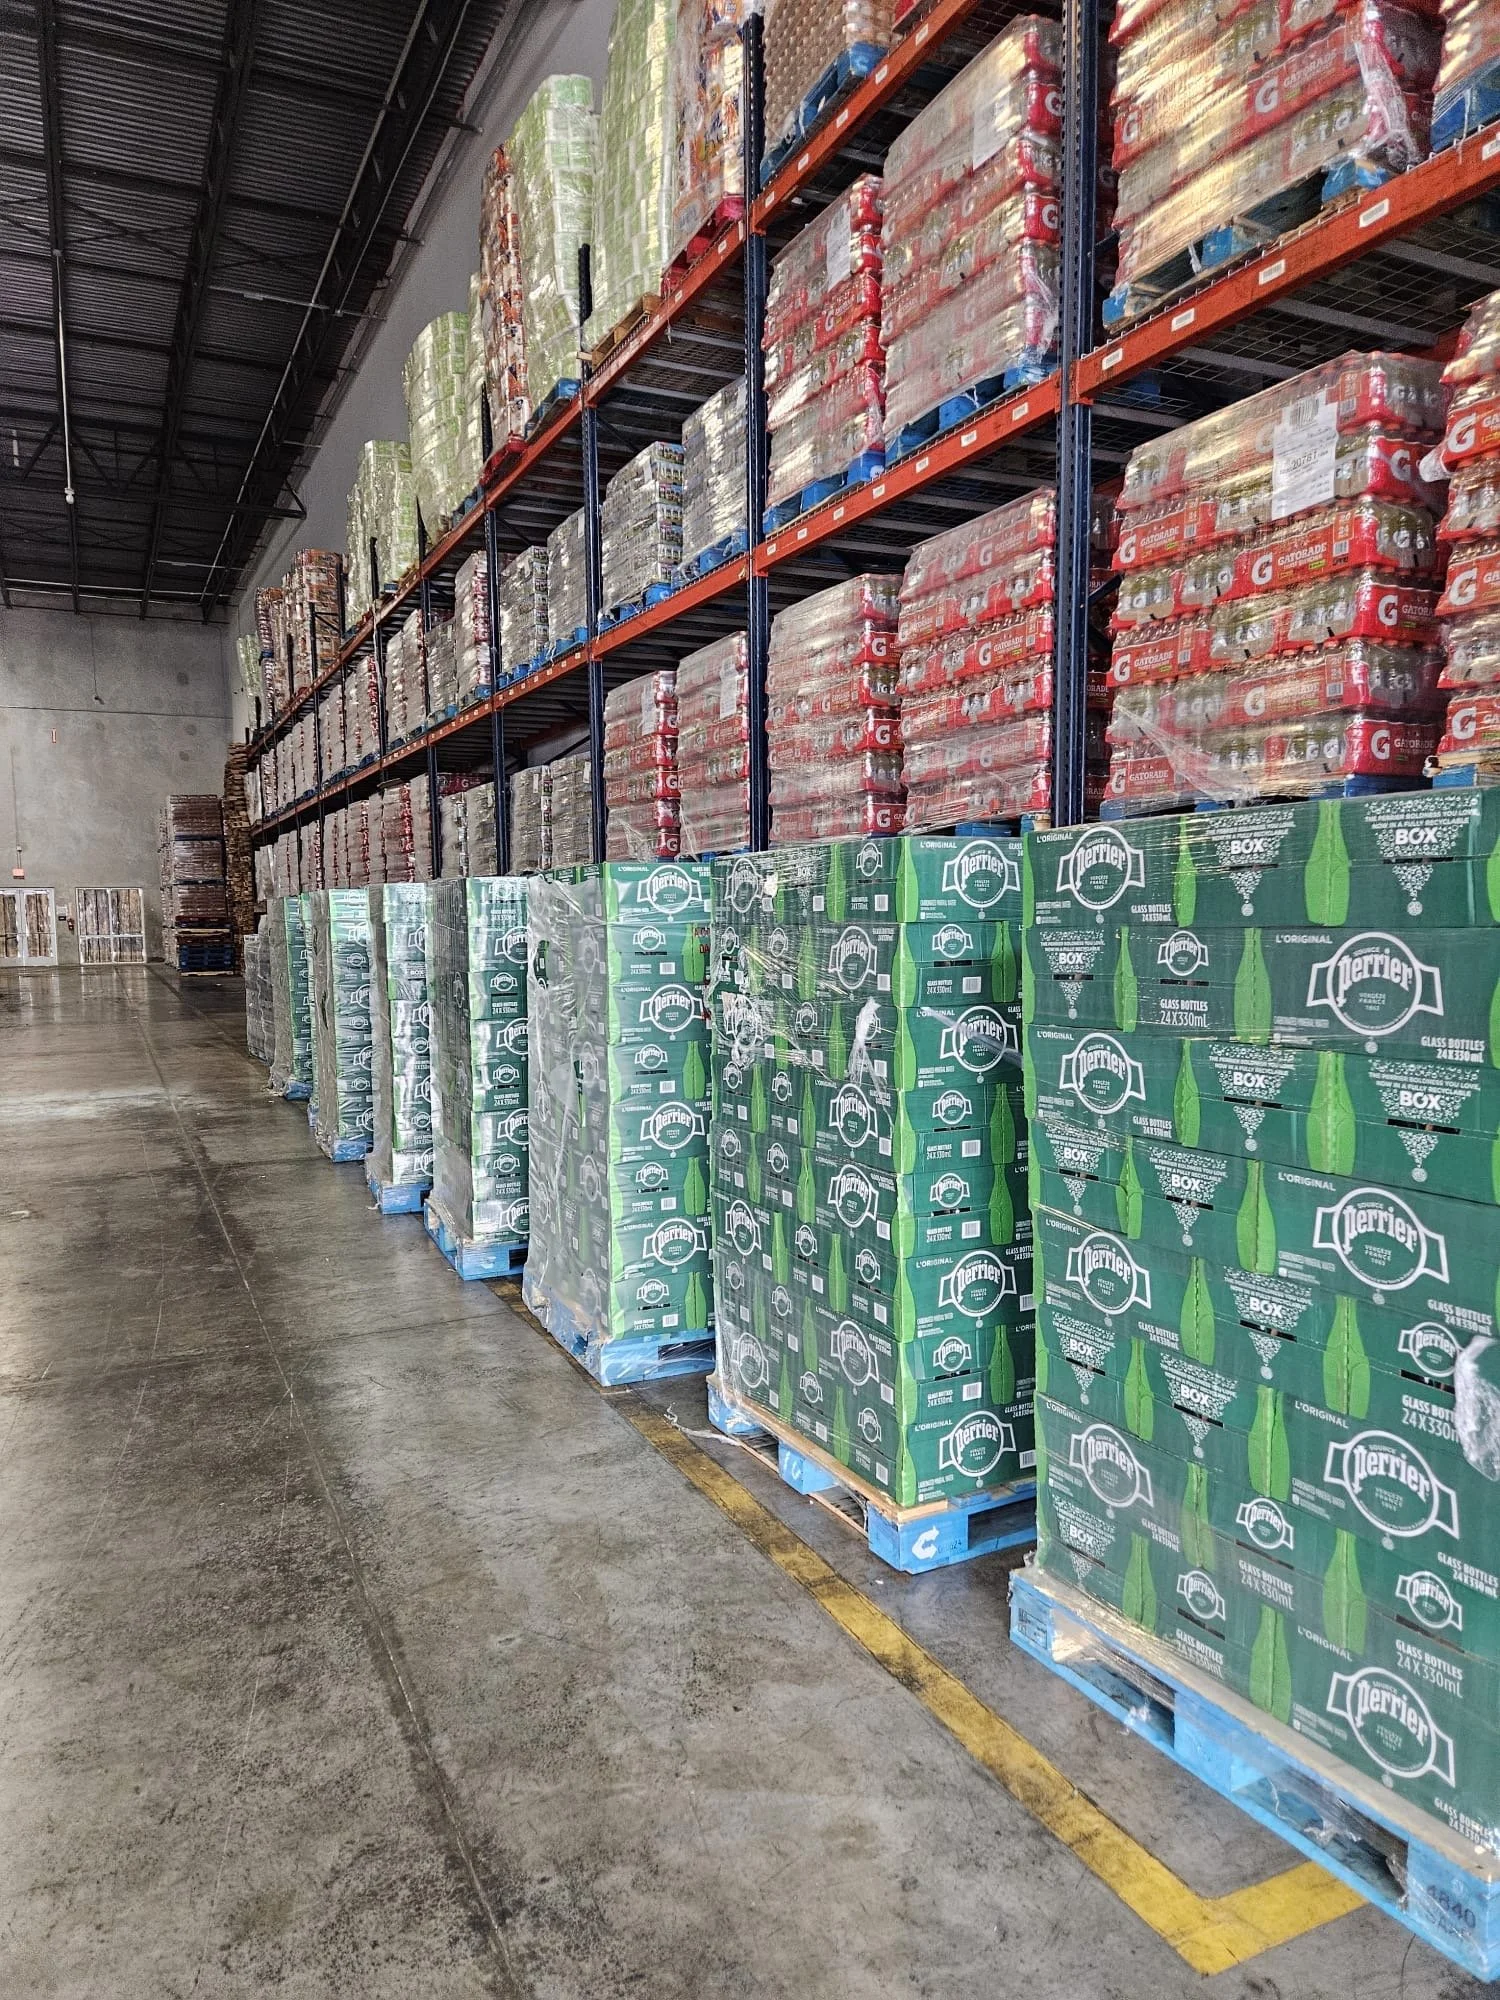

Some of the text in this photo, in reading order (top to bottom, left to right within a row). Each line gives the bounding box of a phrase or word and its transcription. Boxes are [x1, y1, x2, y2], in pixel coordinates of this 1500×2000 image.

[1255, 79, 1279, 113] G
[1448, 413, 1476, 453] G
[1391, 449, 1411, 481] G
[978, 546, 993, 566] G
[1119, 534, 1136, 564] G
[1278, 543, 1327, 565] GATORADE
[1252, 553, 1272, 585] G
[1450, 568, 1477, 606] G
[1378, 595, 1398, 626] G
[1402, 604, 1433, 617] GATORA
[871, 638, 886, 657] G
[978, 641, 993, 666] G
[1114, 654, 1130, 682] G
[1244, 686, 1265, 716] G
[1452, 707, 1477, 739] G
[875, 725, 890, 745] G
[1371, 730, 1390, 760] G
[1111, 768, 1126, 794] G
[876, 809, 891, 828] G
[1036, 832, 1073, 843] L'ORIGINAL
[1395, 828, 1438, 844] BOX
[1231, 839, 1265, 855] BOX
[1131, 904, 1172, 914] GLASS BOTTLES
[1275, 934, 1333, 944] L'ORIGINAL
[1059, 952, 1084, 964] BOX
[1160, 999, 1208, 1012] GLASS BOTTLES
[1160, 1010, 1208, 1028] 24X330mL
[1037, 1030, 1074, 1041] L'ORIGINAL
[1421, 1036, 1485, 1050] GLASS BOTTLES
[1233, 1071, 1265, 1089] BOX
[1400, 1091, 1442, 1110] BOX
[1132, 1116, 1172, 1129] GLASS BOTTLES
[1064, 1147, 1088, 1162] BOX
[1171, 1174, 1201, 1192] BOX
[1278, 1171, 1336, 1192] L'ORIGINAL
[1046, 1219, 1081, 1235] L'ORIGINAL
[1018, 1245, 1033, 1253] BOTTL
[916, 1257, 954, 1269] L'ORIGINAL
[1250, 1297, 1283, 1318] BOX
[1427, 1299, 1492, 1324] GLASS BOTTLES
[1069, 1339, 1094, 1356] BOX
[1180, 1384, 1210, 1405] BOX
[1005, 1405, 1016, 1414] GLASS
[1047, 1402, 1082, 1424] L'ORIGINAL
[1295, 1401, 1349, 1429] L'ORIGINAL
[1402, 1395, 1455, 1420] GLASS BOTT
[915, 1419, 953, 1432] L'ORIGINAL
[1069, 1525, 1094, 1546] BOX
[1238, 1559, 1293, 1595] GLASS BOTTLES
[1437, 1552, 1499, 1588] GLASS BOTTLES
[1241, 1572, 1295, 1611] 24X330mL
[1176, 1628, 1224, 1665] GLASS BOTTLES
[1298, 1625, 1352, 1662] L'ORIGINAL
[1395, 1639, 1464, 1680] GLASS BOTTLES
[1397, 1652, 1463, 1698] 24X330mL
[1434, 1798, 1458, 1818] GLASS
